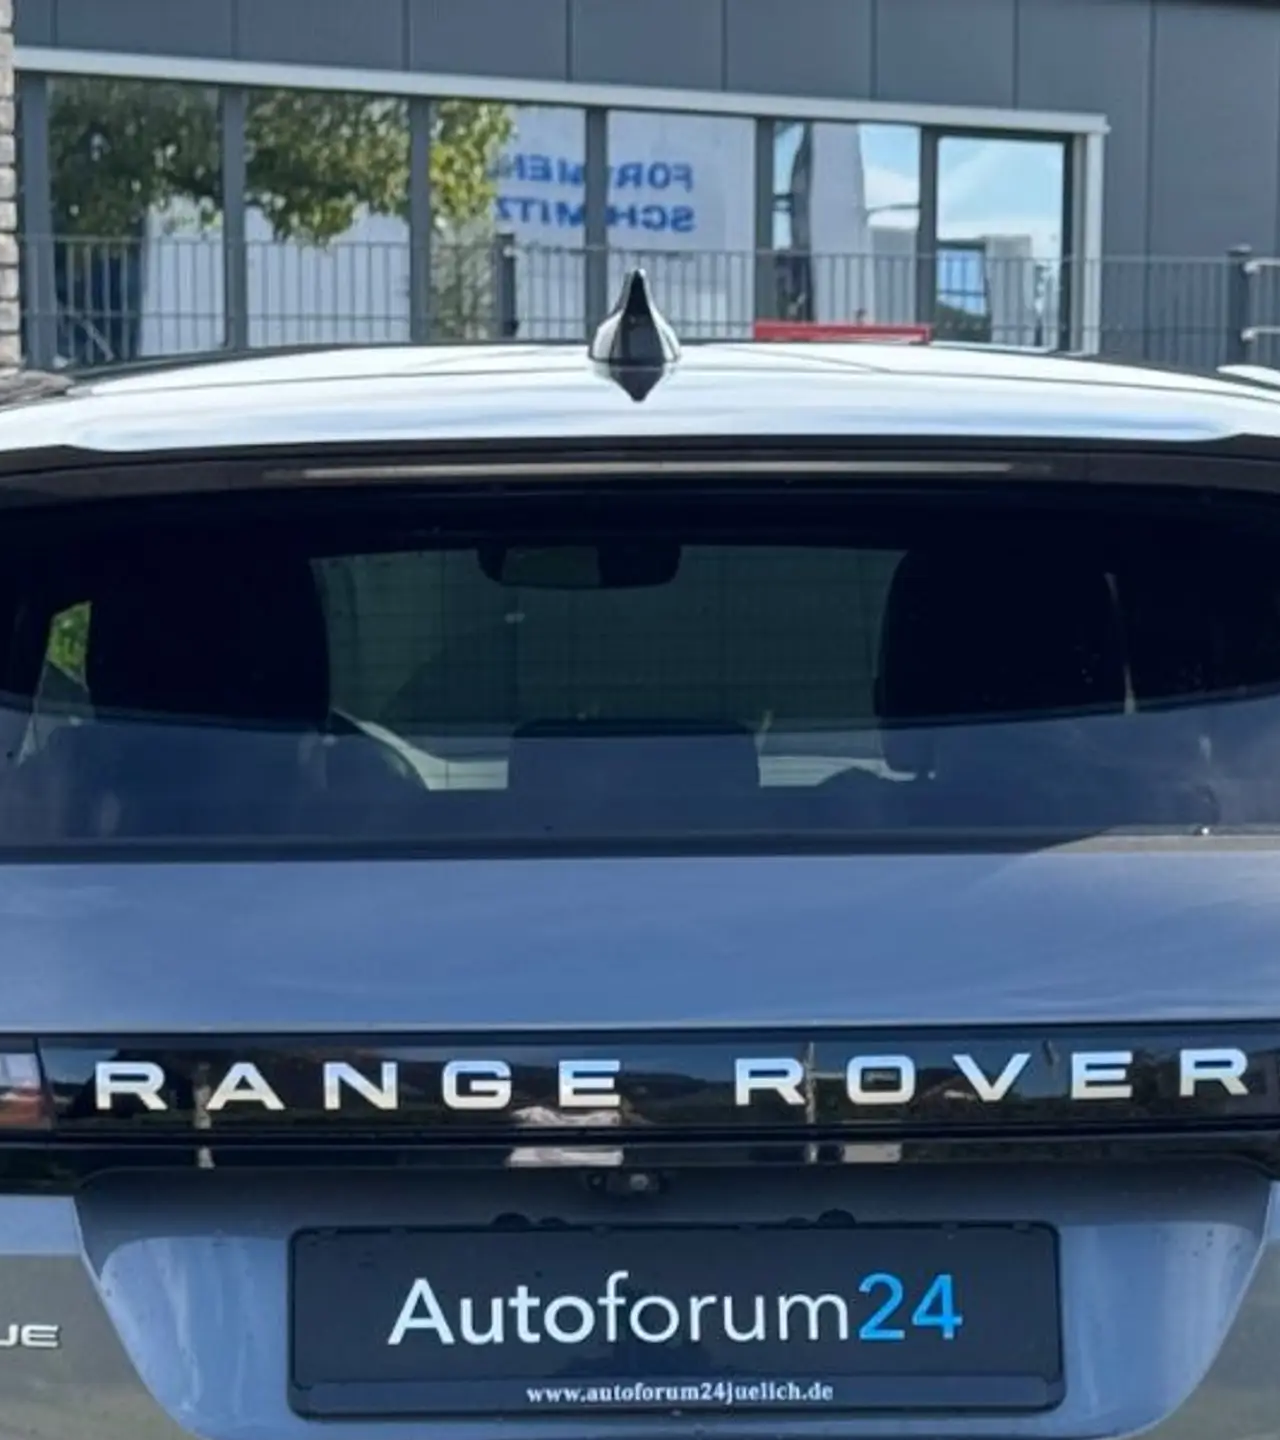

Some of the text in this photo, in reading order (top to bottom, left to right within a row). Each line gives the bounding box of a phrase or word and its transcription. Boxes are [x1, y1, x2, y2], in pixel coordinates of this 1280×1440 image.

[93, 1047, 1250, 1111] RANGE ROVER
[387, 1270, 964, 1345] Autoforum24
[526, 1381, 834, 1406] www.autoforum24juelich.de
